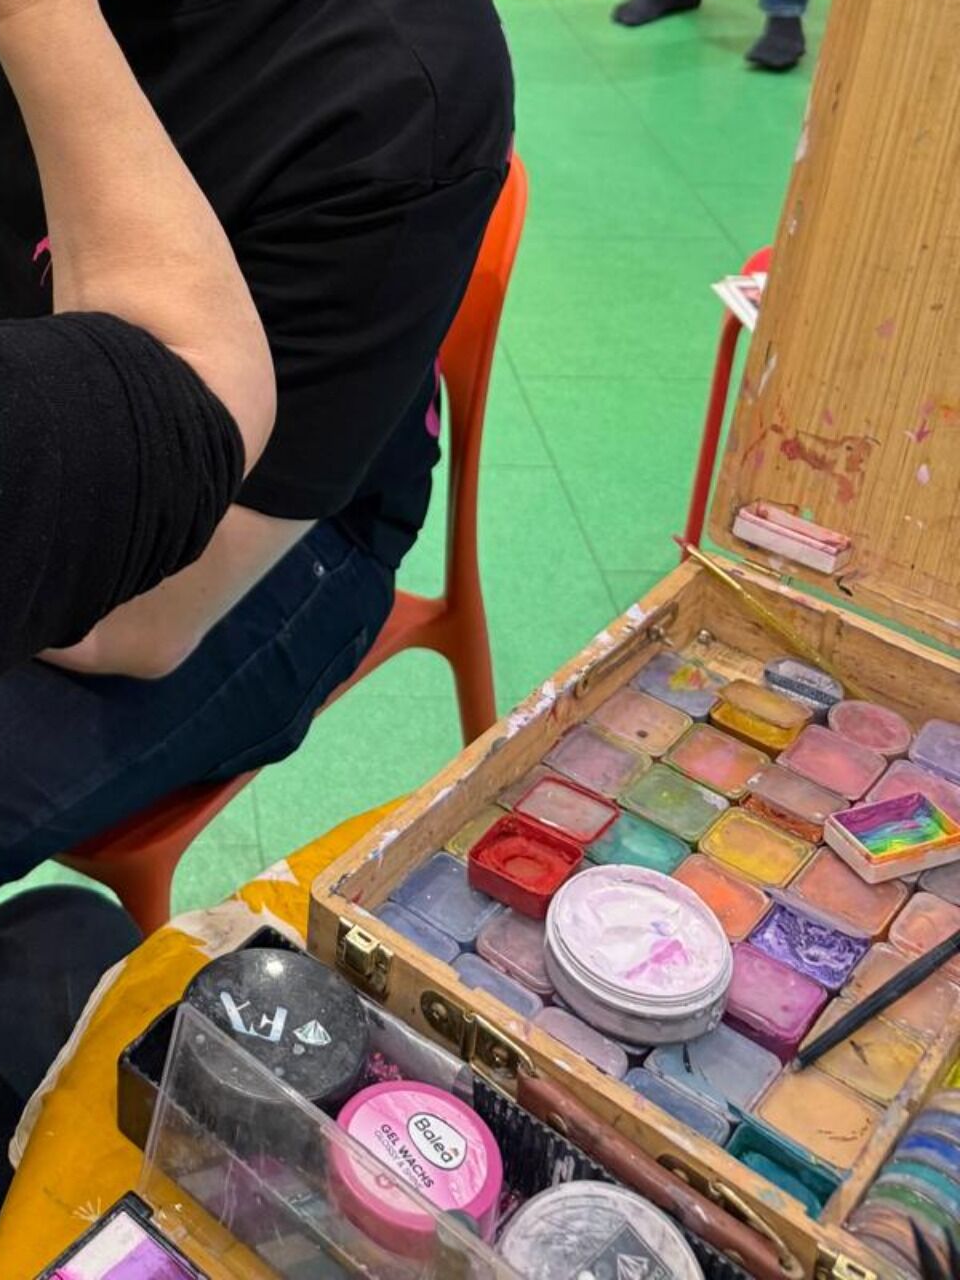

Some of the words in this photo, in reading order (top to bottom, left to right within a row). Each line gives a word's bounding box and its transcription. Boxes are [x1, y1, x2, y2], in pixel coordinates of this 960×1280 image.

[381, 1124, 400, 1146] GEL
[399, 1145, 434, 1188] WACHS
[414, 1117, 453, 1163] Balea
